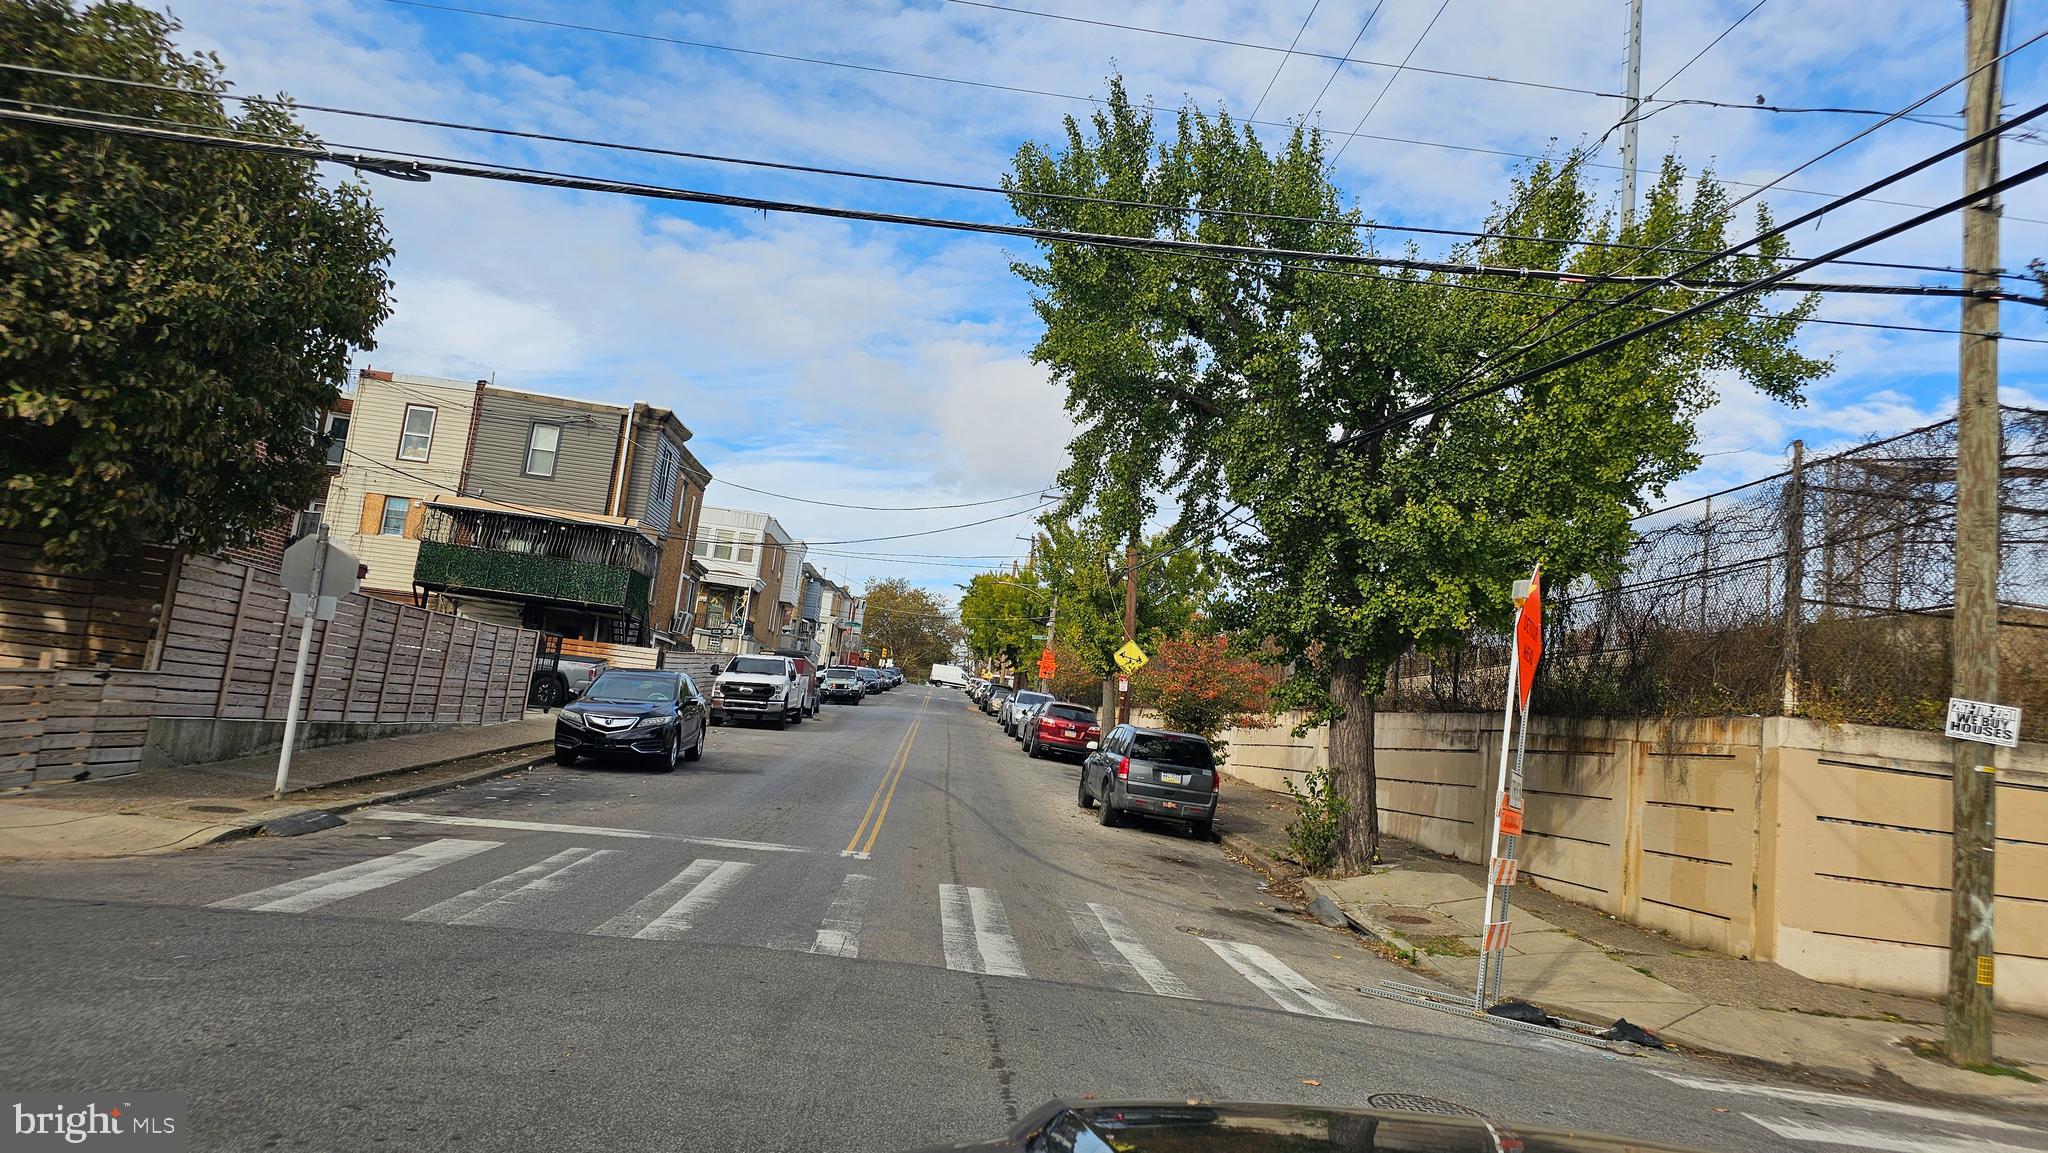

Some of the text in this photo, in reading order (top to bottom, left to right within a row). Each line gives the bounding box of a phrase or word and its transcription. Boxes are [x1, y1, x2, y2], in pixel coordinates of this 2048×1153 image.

[1523, 614, 1538, 641] DETOUR
[1951, 721, 2013, 740] HOUSES
[1957, 713, 2010, 729] WE BUY
